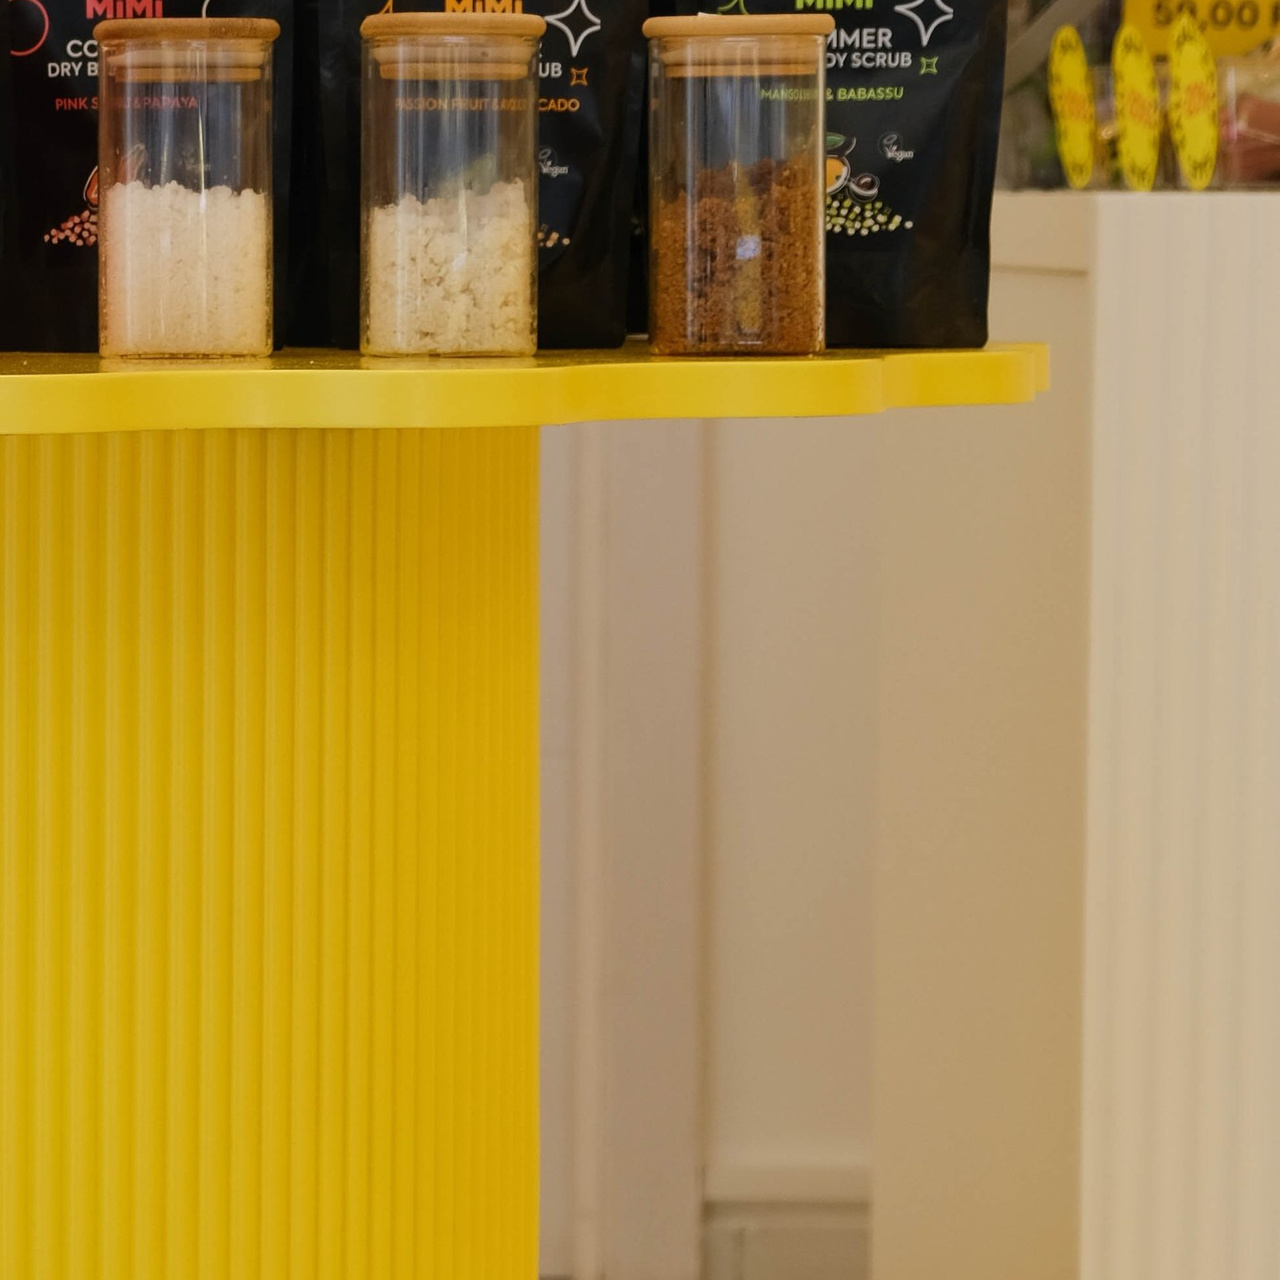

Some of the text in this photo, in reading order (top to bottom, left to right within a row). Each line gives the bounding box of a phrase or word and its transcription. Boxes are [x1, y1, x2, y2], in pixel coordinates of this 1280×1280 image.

[852, 52, 912, 68] SCRUB
[48, 62, 82, 78] DRY
[837, 87, 904, 100] BABASSU
[55, 97, 87, 111] PINK
